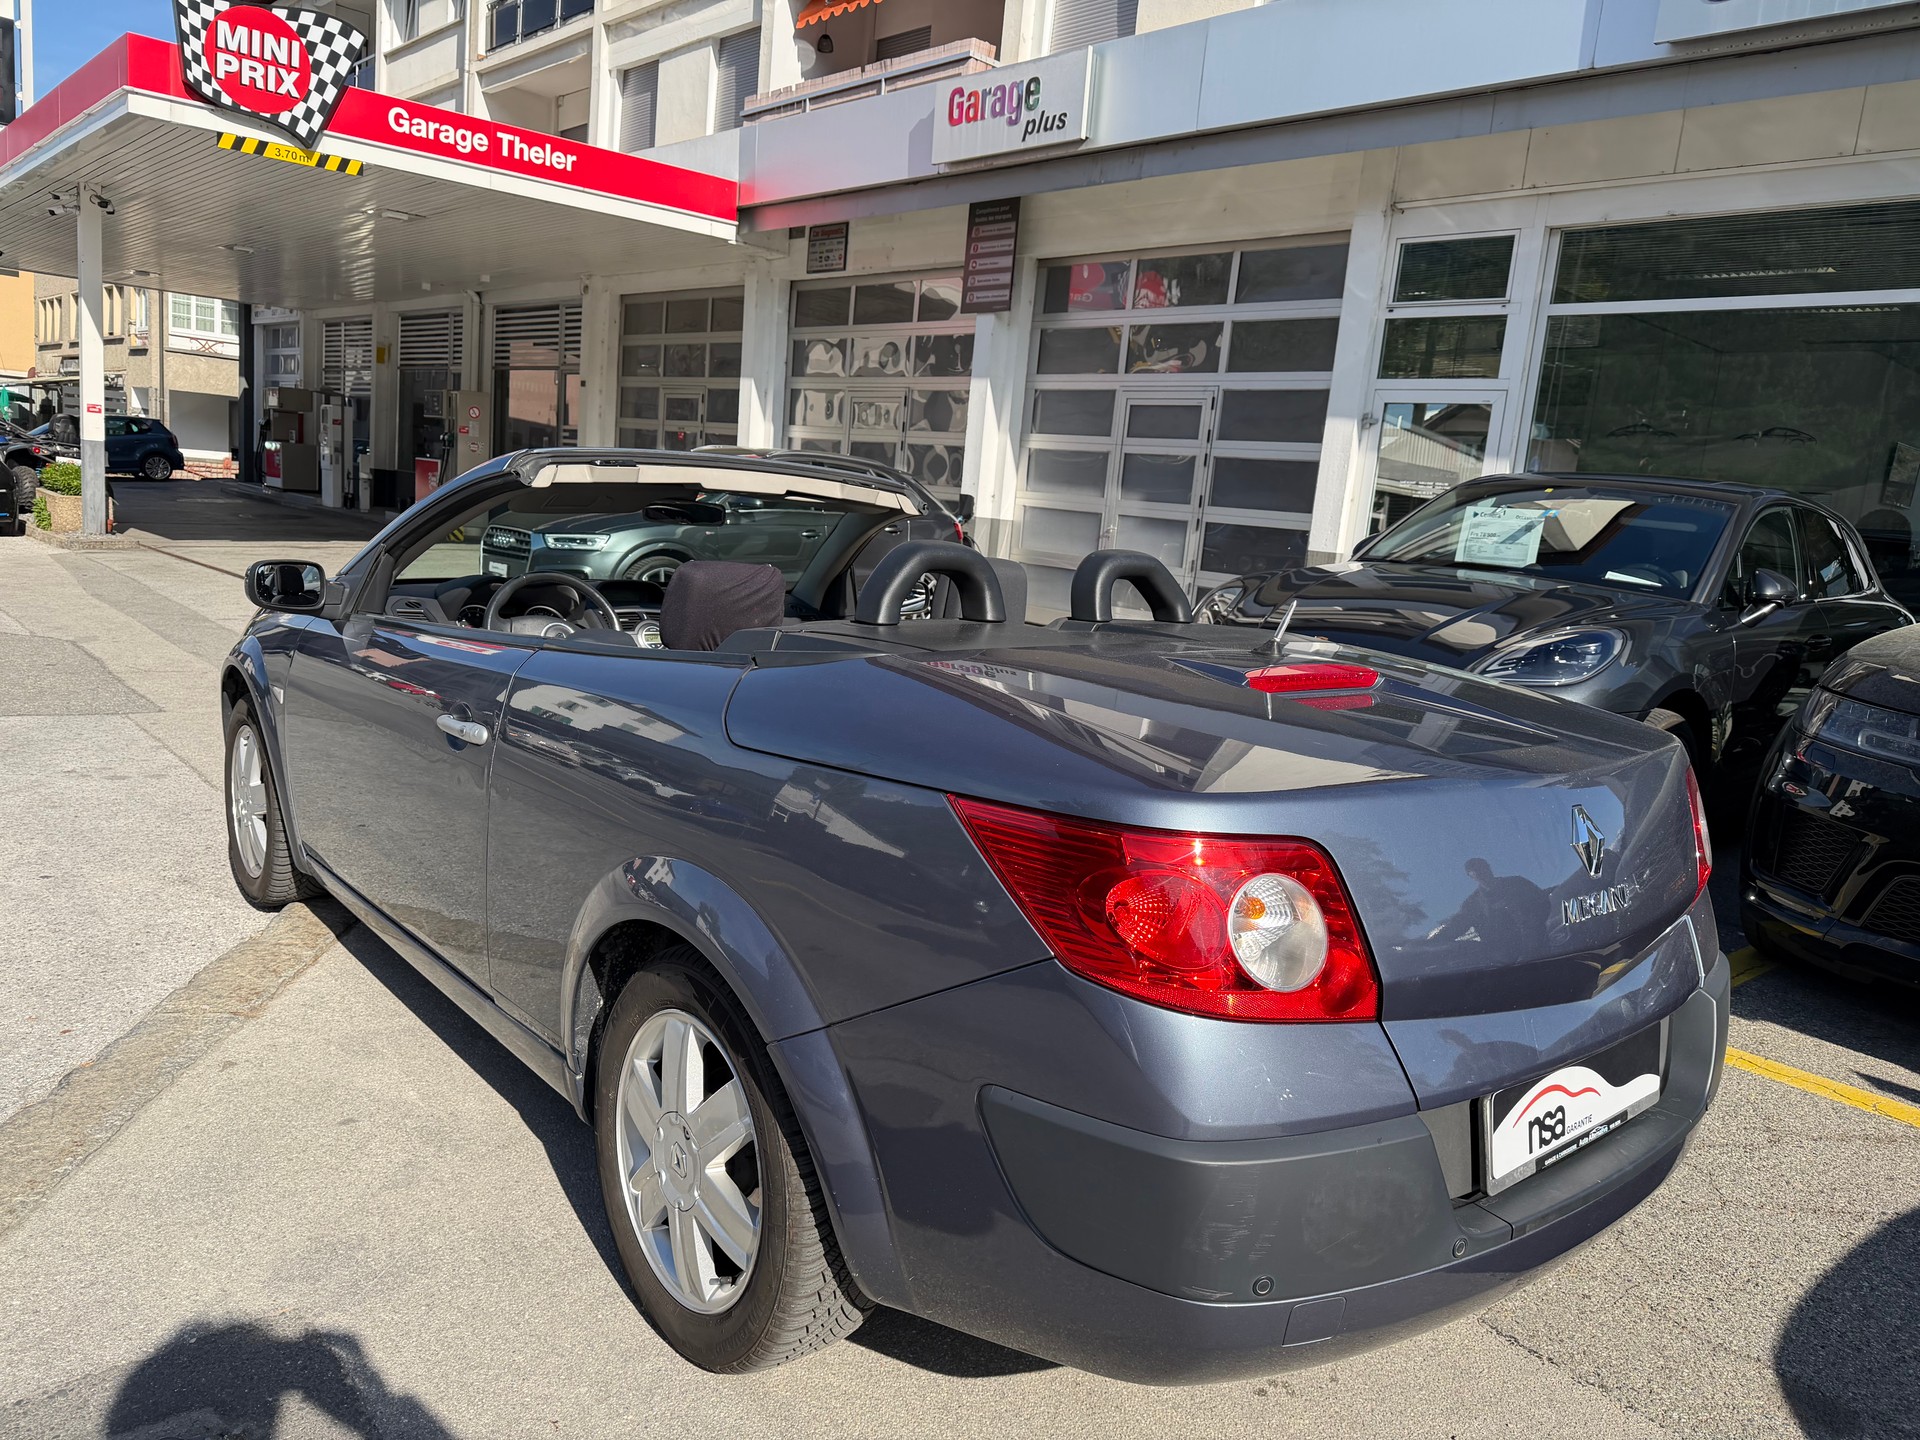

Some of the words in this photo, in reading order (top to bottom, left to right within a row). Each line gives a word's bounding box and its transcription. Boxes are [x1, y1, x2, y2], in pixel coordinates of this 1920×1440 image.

[216, 19, 300, 69] MINI
[216, 52, 300, 99] PRIX
[948, 76, 1041, 127] Garage
[388, 107, 489, 153] Garage
[497, 131, 577, 171] Theler
[1021, 110, 1067, 142] plus
[274, 147, 297, 160] 3.70
[1528, 1105, 1566, 1154] nsa
[1566, 1114, 1593, 1134] GARANTIE
